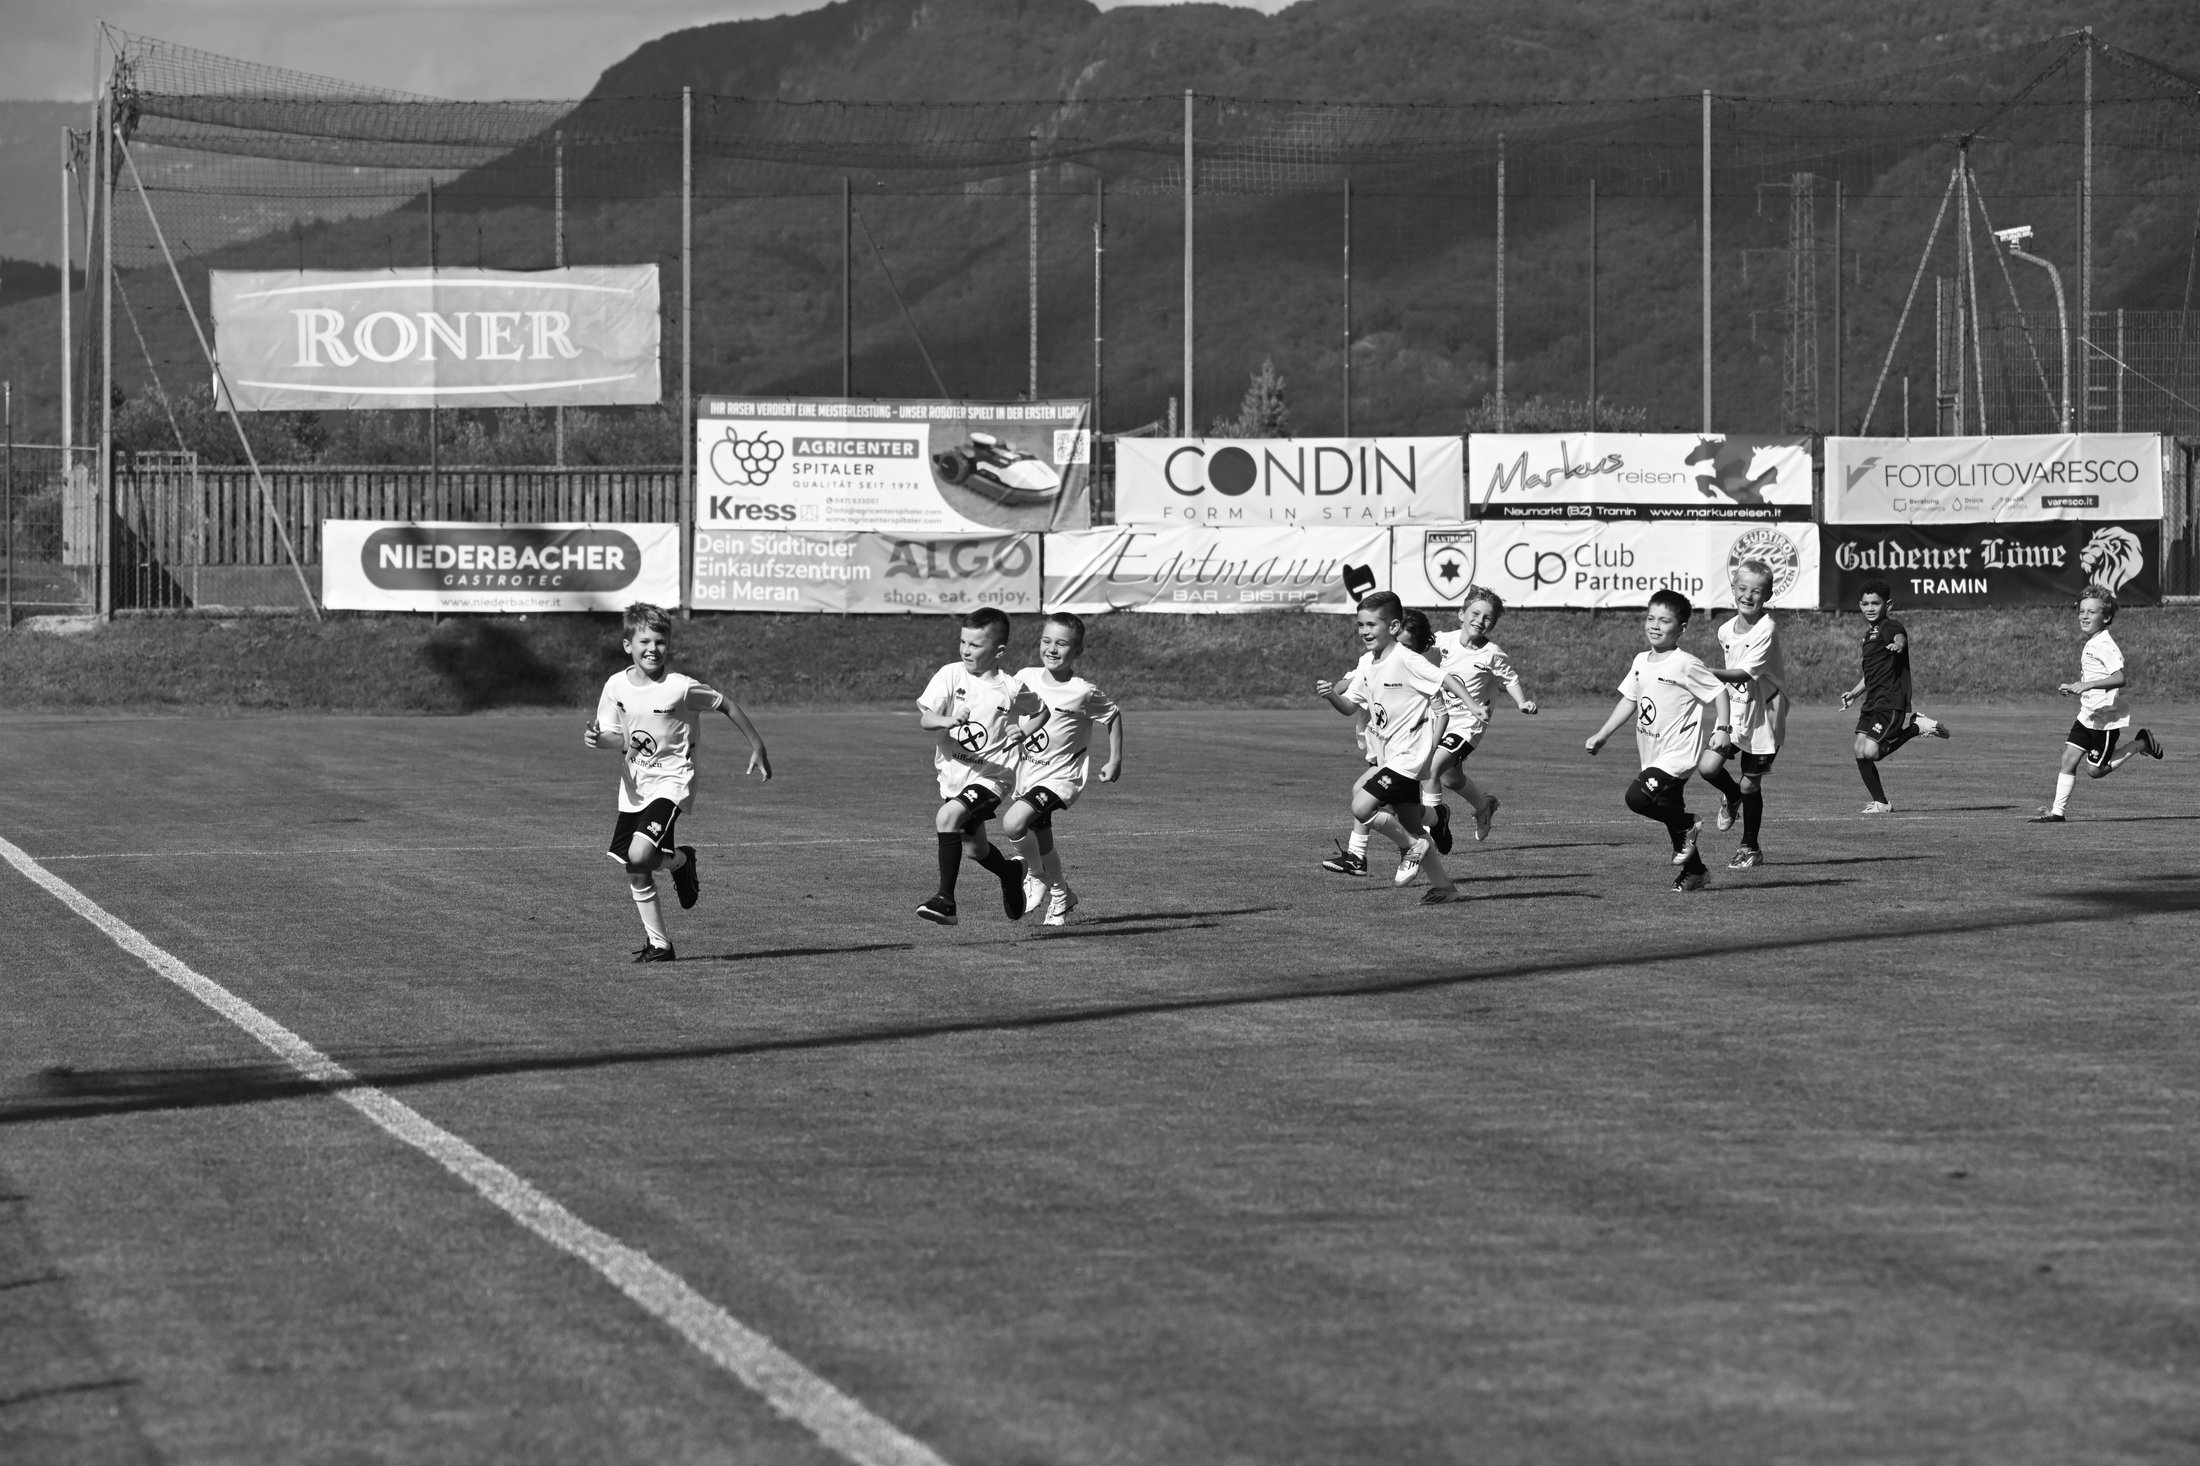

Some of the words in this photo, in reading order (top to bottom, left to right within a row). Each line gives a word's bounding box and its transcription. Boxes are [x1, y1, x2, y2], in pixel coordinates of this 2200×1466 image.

[289, 308, 582, 367] RONER
[711, 402, 726, 415] IHR
[727, 403, 755, 416] RASEN
[757, 403, 797, 417] VERDIENT
[798, 403, 817, 417] EINE
[818, 404, 891, 418] MEISTERLEISTUNG
[900, 405, 927, 419] UNSER
[929, 405, 966, 419] ROBOTER
[968, 406, 995, 420] SPIELT
[996, 406, 1005, 419] IN
[1007, 406, 1023, 420] DER
[1025, 406, 1056, 419] ERSTEN
[798, 440, 914, 456] AGRICENTER
[792, 462, 875, 475] SPITALER
[1164, 445, 1417, 497] CONDIN
[1481, 440, 1624, 513] Markus
[1618, 468, 1686, 484] reisen
[1885, 460, 2139, 488] FOTOLITOVARESCO
[793, 480, 852, 489] QUALITÄT
[858, 481, 885, 489] SEIT
[892, 482, 919, 490] 1978
[710, 495, 797, 521] Kress
[1163, 506, 1243, 519] FORM
[1270, 507, 1296, 519] IN
[1323, 506, 1417, 519] STAHL
[1504, 506, 1564, 517] Neumarkt
[1566, 506, 1592, 518] (BZ)
[1596, 506, 1637, 517] Tramin
[1649, 507, 1782, 518] www.markusreisen.it
[2047, 497, 2094, 507] varesco.it
[379, 543, 626, 571] NIEDERBACHER
[696, 534, 744, 554] Dein
[751, 534, 856, 557] Südtiroler
[1574, 543, 1635, 567] Club
[1733, 544, 1745, 559] FC
[1742, 531, 1796, 560] SÜDTIROL
[1835, 538, 1971, 571] Goldener
[695, 557, 871, 580] Einkaufszentrum
[884, 540, 1033, 579] ALGO
[1106, 532, 1343, 609] Egetmann
[444, 574, 562, 586] GASTROTEC
[694, 580, 727, 600] bei
[733, 581, 799, 602] Meran
[1575, 570, 1704, 597] Partnership
[1774, 569, 1796, 597] BOZEN
[1911, 578, 1988, 595] TRAMIN
[441, 597, 561, 607] www.niederbacher.it
[883, 588, 931, 606] shop.
[939, 590, 972, 604] eat.
[978, 589, 1031, 607] enjoy.
[1173, 590, 1218, 602] BAR
[1240, 590, 1318, 602] BISTRO
